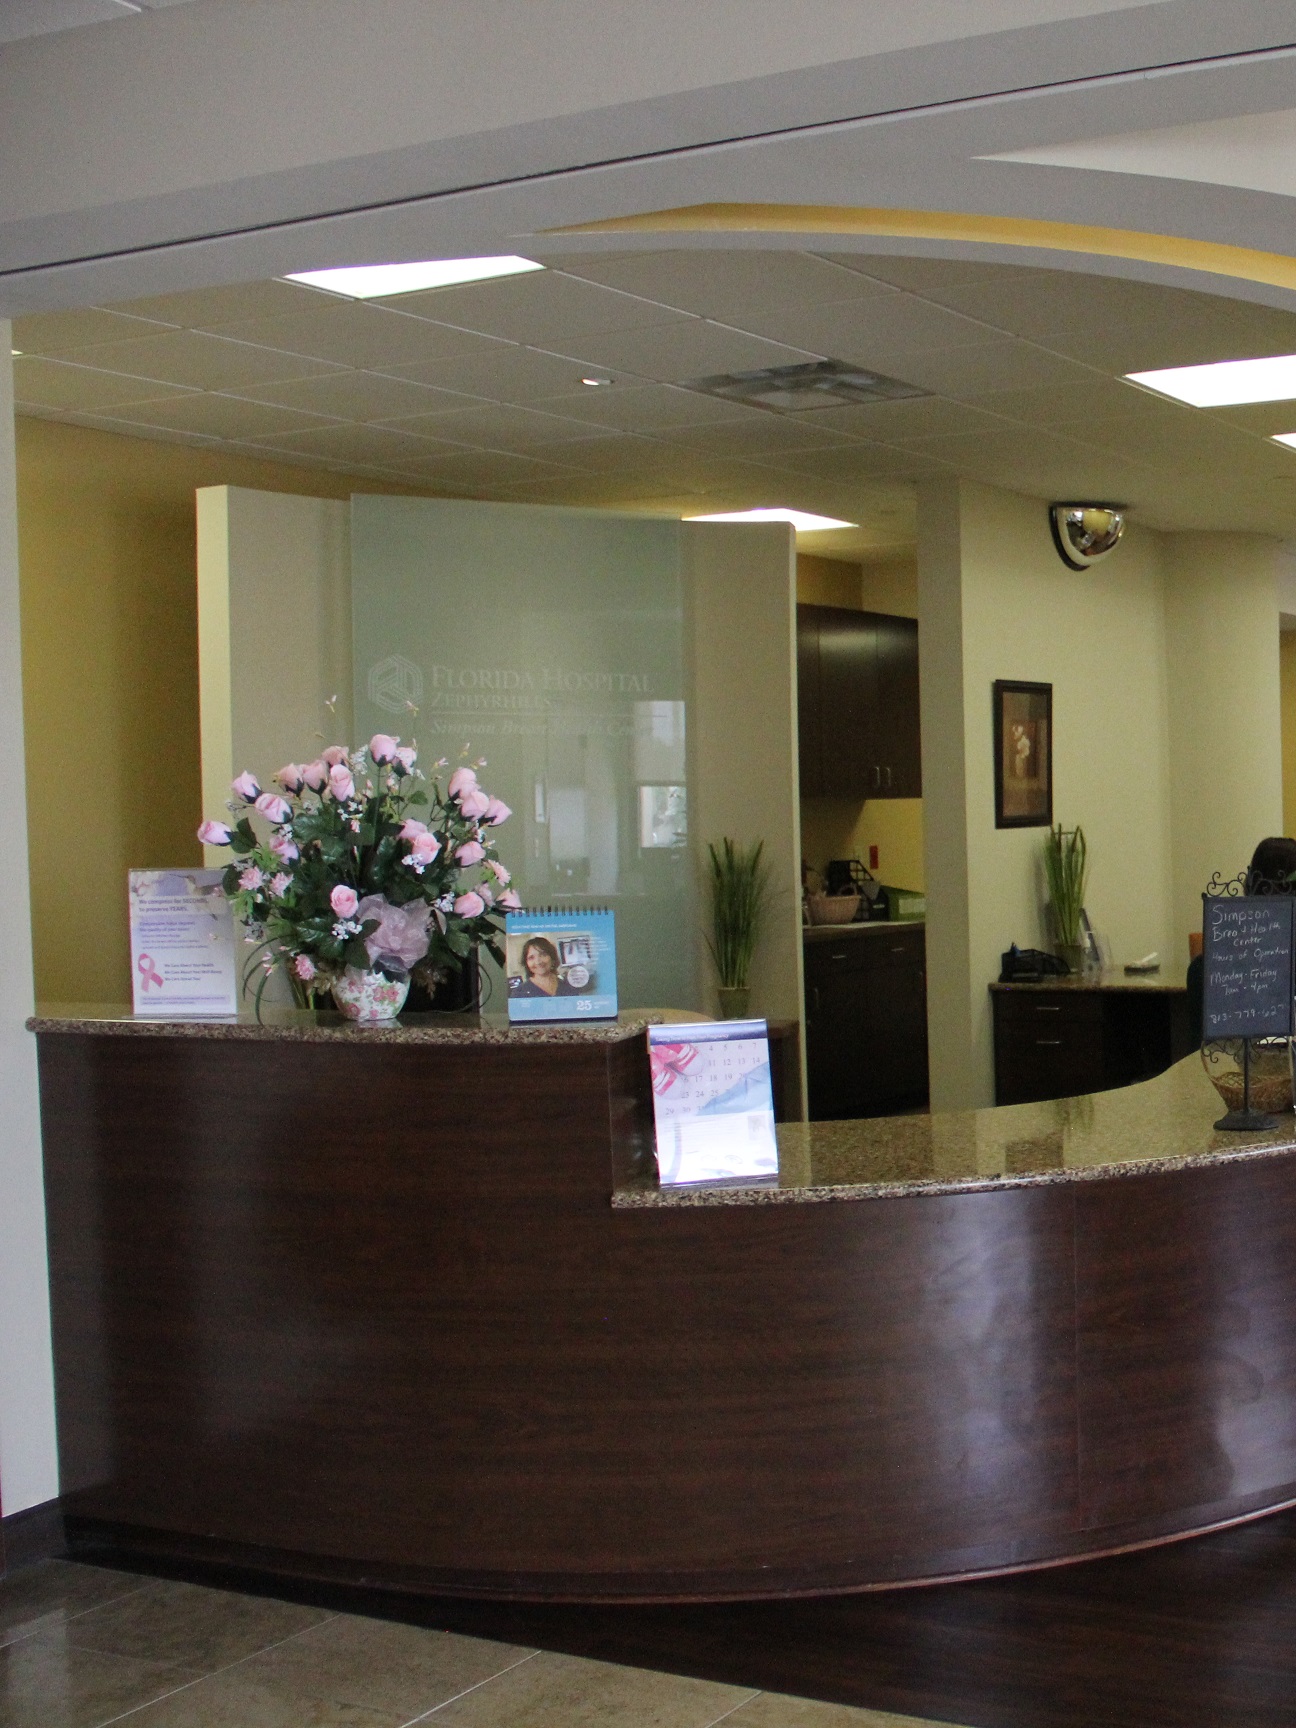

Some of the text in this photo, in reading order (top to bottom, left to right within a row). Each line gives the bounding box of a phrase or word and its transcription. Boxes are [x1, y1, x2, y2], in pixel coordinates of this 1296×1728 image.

[431, 664, 655, 693] FLORIDA HOSPITAL
[1212, 904, 1270, 926] Simpson
[1212, 925, 1247, 942] Breat
[576, 999, 593, 1012] 25
